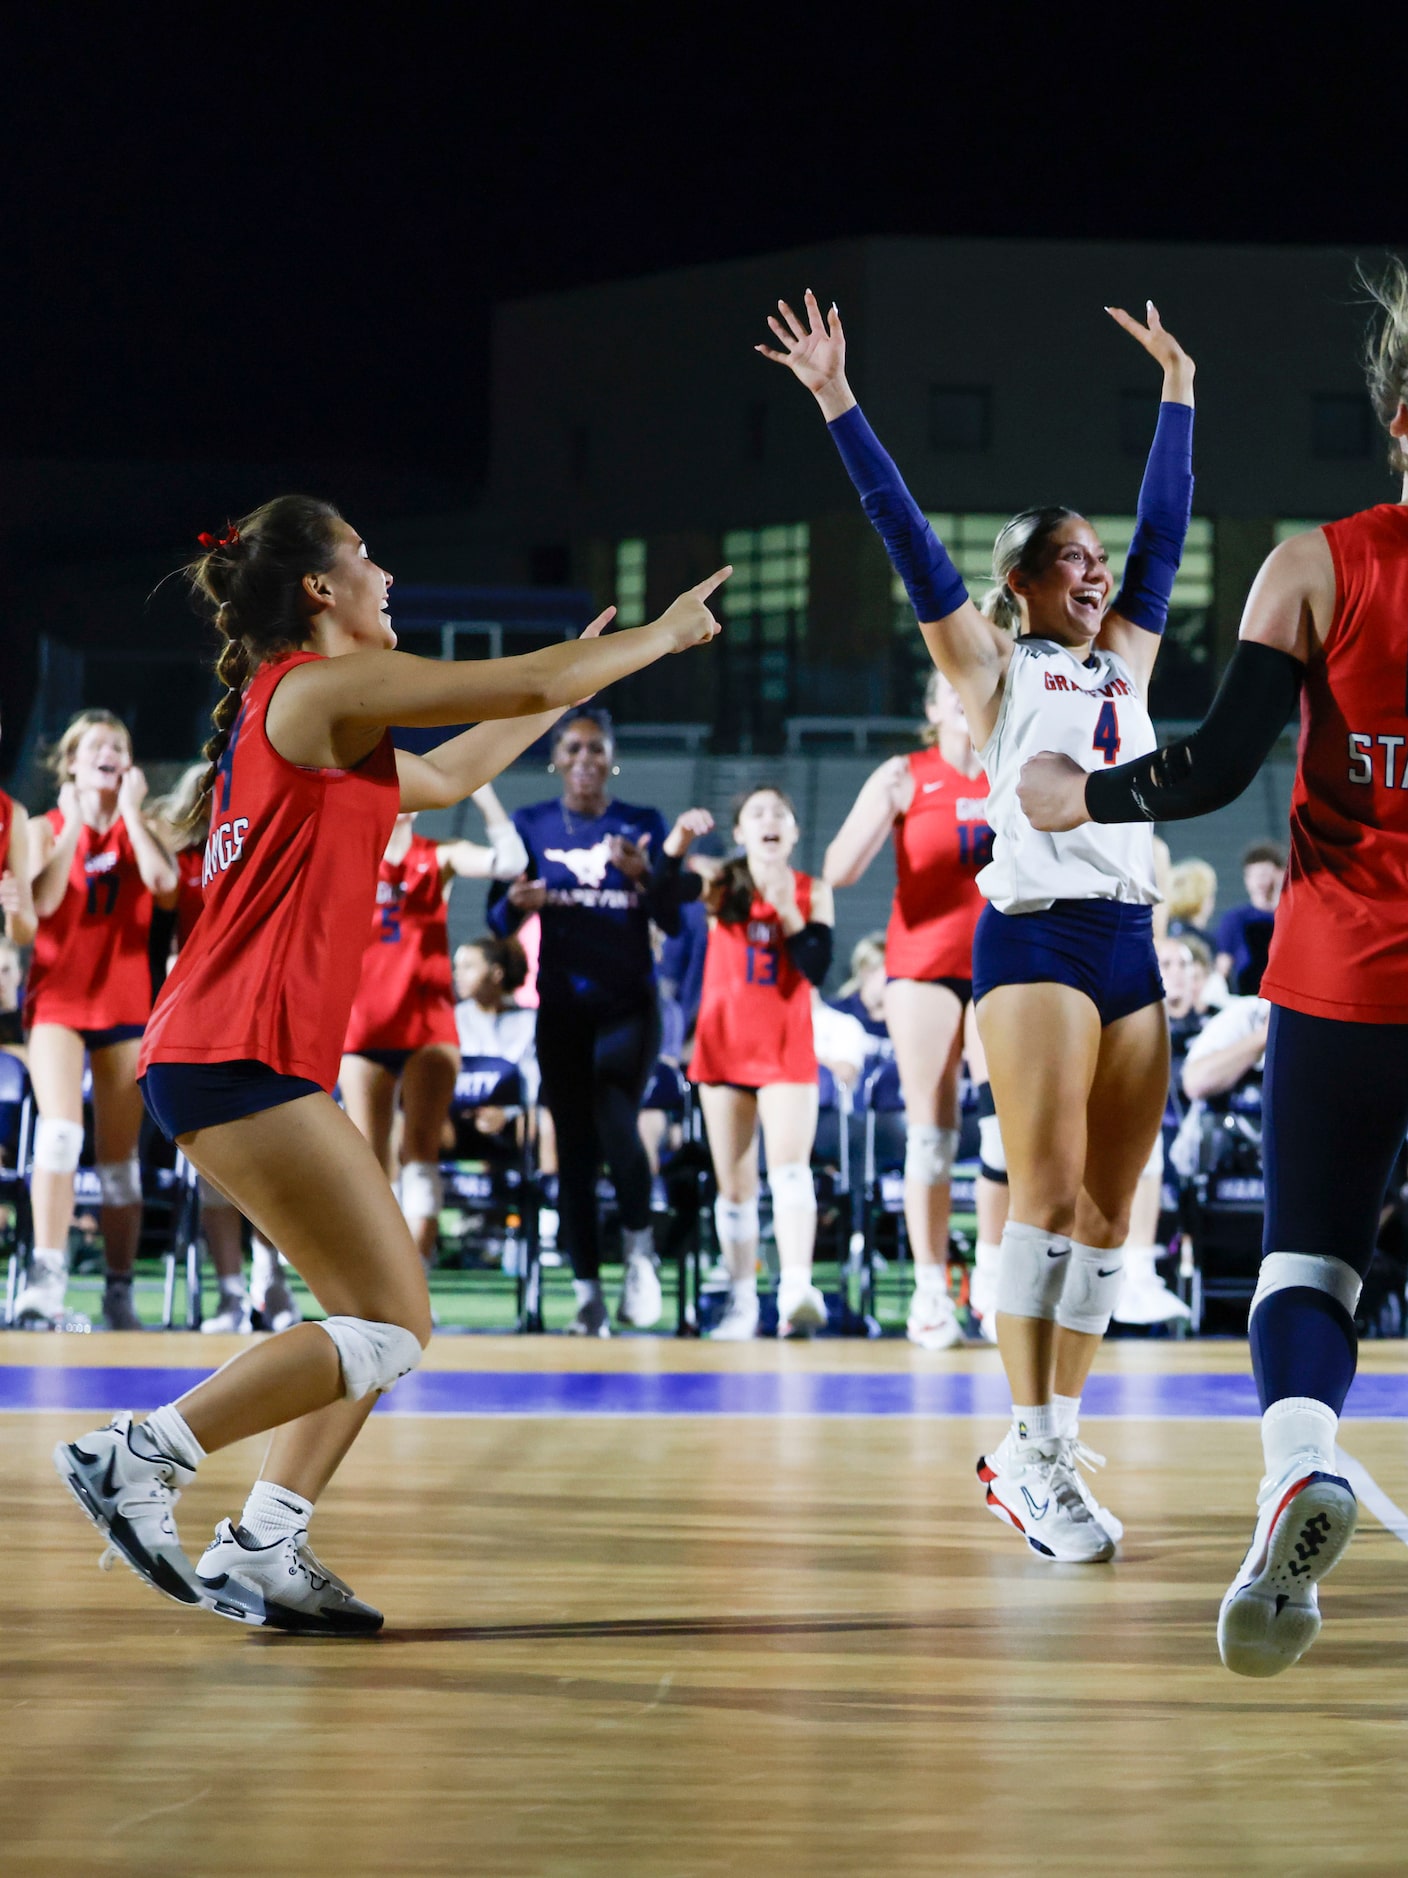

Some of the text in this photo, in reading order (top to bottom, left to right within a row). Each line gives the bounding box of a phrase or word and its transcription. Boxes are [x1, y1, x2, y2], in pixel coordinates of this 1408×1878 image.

[1092, 700, 1121, 765] 4
[86, 874, 120, 914] 17
[381, 905, 401, 943] 5
[745, 946, 778, 986] 13
